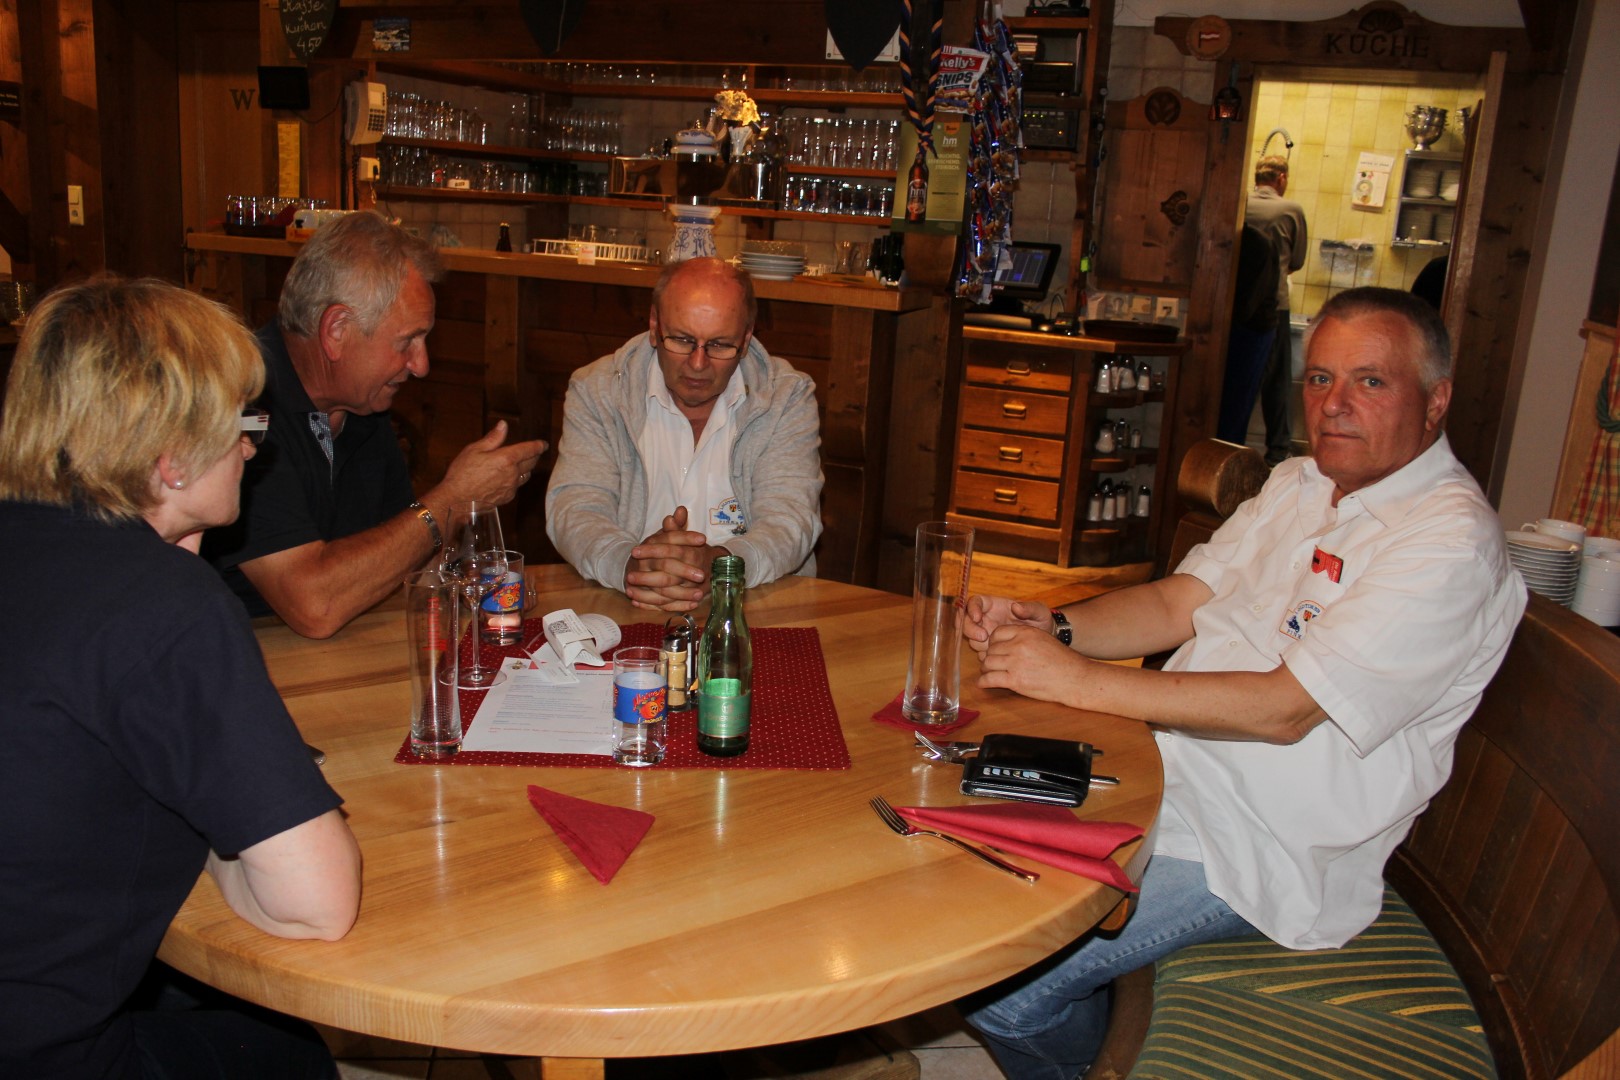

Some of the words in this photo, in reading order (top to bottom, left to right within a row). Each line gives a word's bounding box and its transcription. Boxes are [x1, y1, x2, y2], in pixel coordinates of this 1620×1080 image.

[1325, 33, 1430, 57] KÜCHE
[228, 88, 261, 111] W
[942, 135, 958, 145] hm
